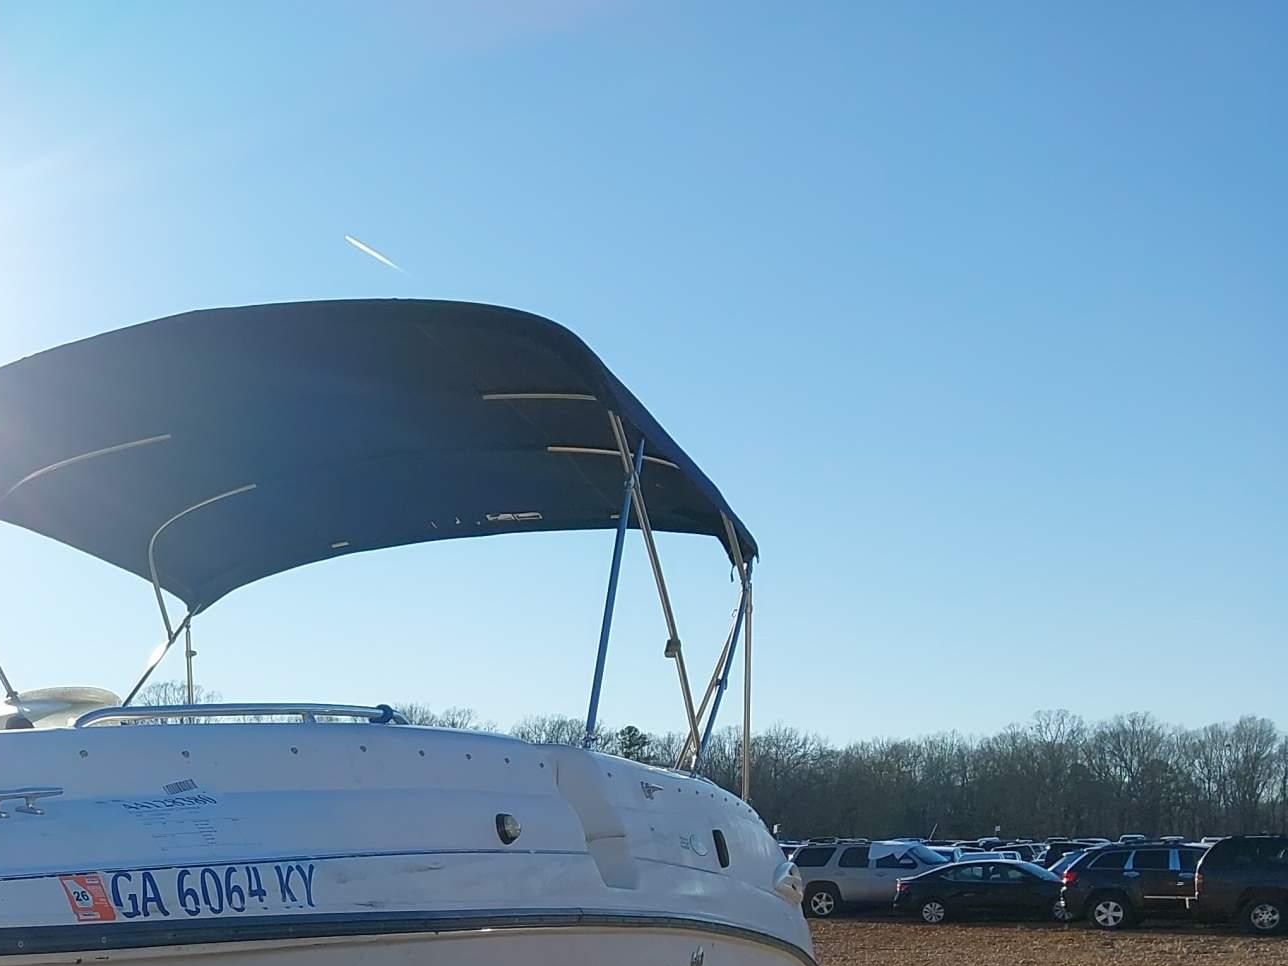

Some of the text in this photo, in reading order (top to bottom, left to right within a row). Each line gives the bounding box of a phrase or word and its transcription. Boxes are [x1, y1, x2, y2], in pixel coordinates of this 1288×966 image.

[73, 890, 90, 902] 26
[111, 863, 315, 918] GA 6064 KY
